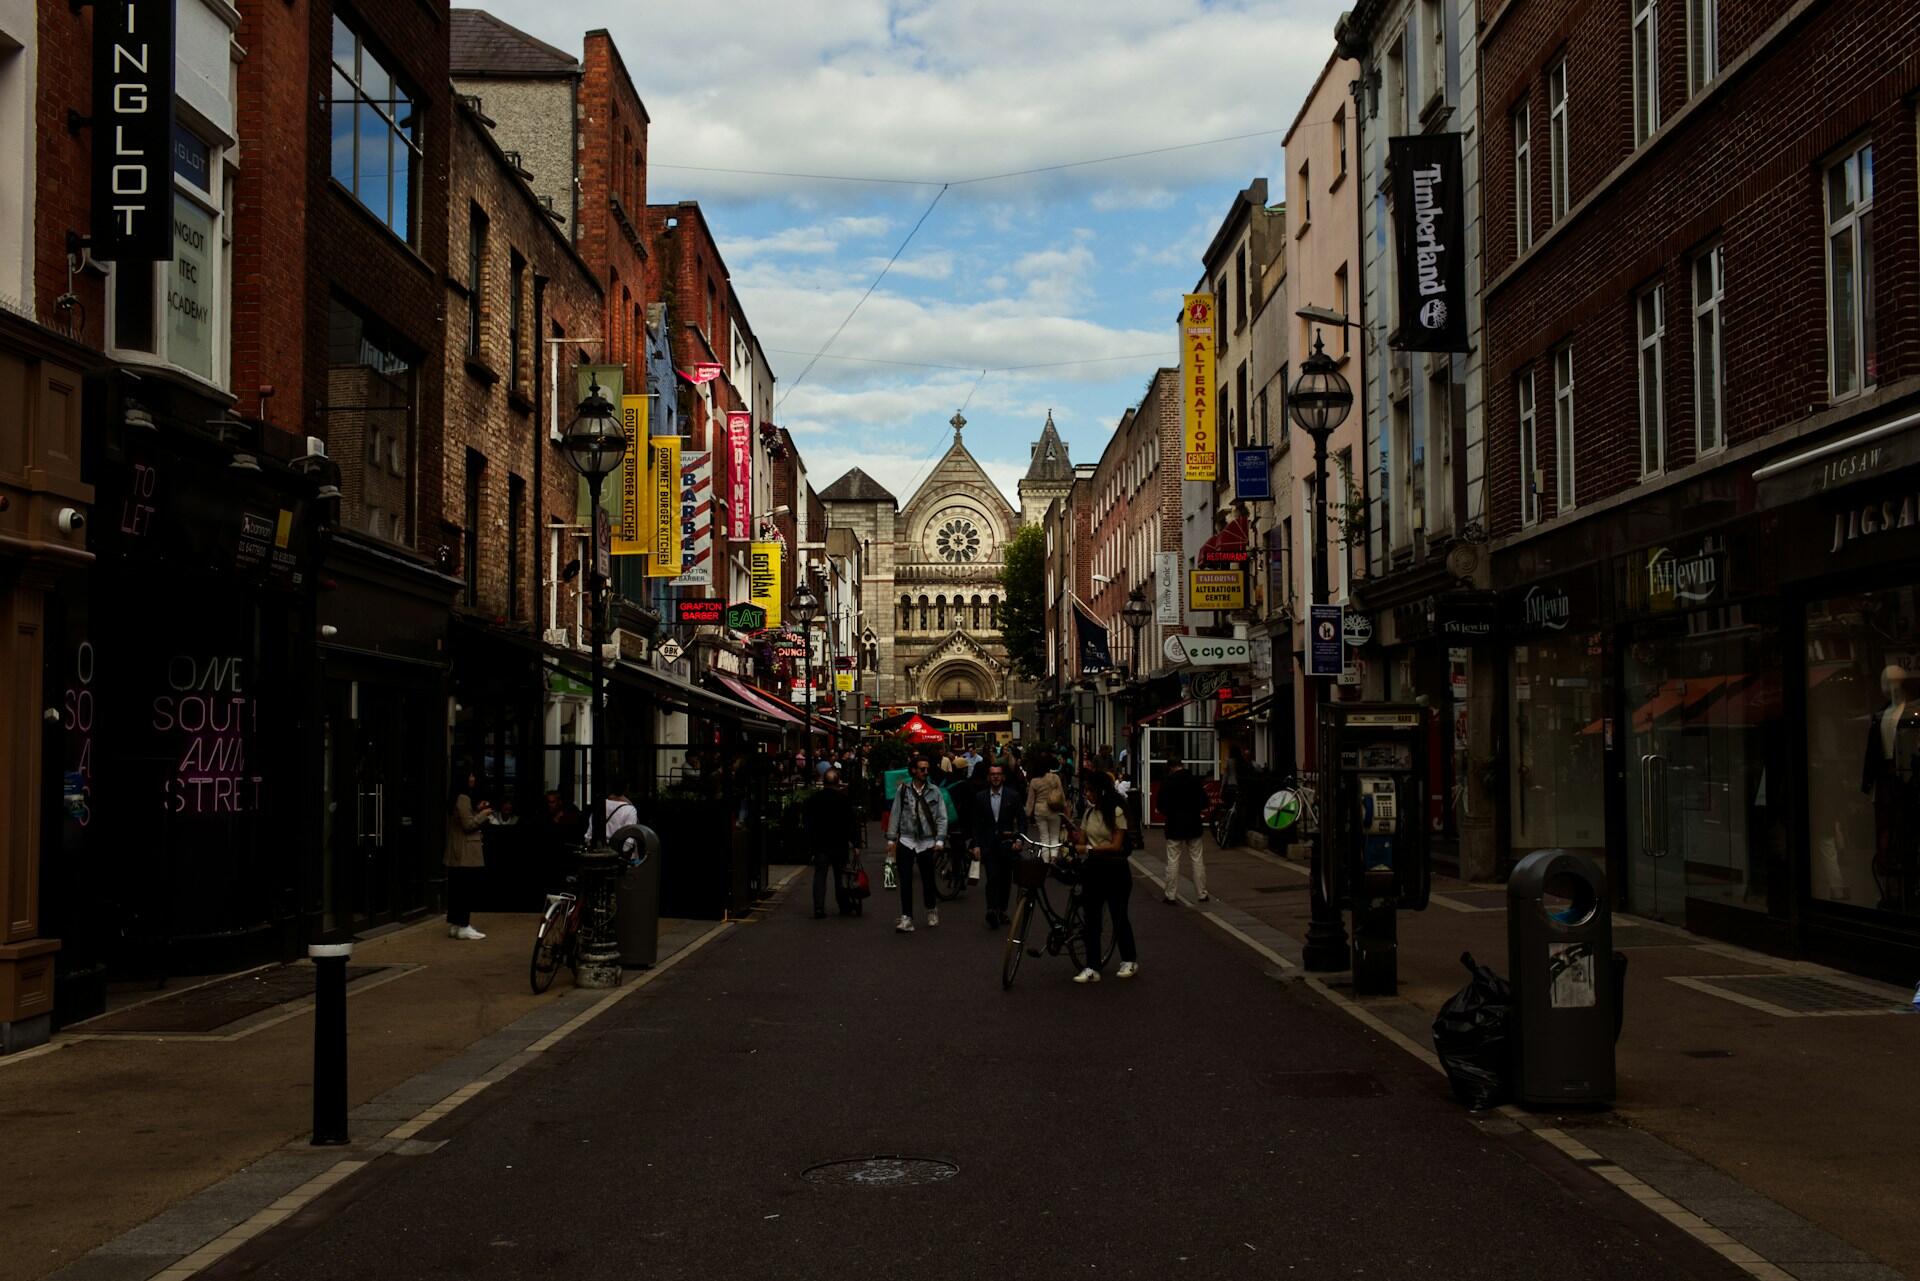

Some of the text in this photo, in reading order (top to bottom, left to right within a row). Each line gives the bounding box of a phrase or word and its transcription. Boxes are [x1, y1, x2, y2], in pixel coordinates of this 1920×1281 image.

[111, 2, 149, 237] INGLOT
[1412, 163, 1447, 297] Timberland
[178, 260, 197, 284] ITEC
[1193, 342, 1207, 452] ALTERATION
[624, 408, 635, 542] GOURMET BURGER KITCHEN
[1187, 453, 1214, 464] CENTRE
[1821, 447, 1882, 490] JIGSAW
[134, 463, 156, 498] TO
[733, 447, 744, 538] DINER
[120, 498, 155, 536] LET
[658, 447, 669, 566] GOURMET BURGER KITCHEN
[682, 472, 697, 568] BARBER
[752, 552, 775, 599] GOTHAM
[1195, 585, 1241, 593] ALTERATIONS
[1199, 574, 1237, 582] TAILORING
[679, 602, 722, 611] GRAFTON
[682, 611, 719, 621] BARBER
[728, 610, 763, 627] EAT
[1190, 645, 1245, 659] e cig co
[168, 655, 243, 693] ONE
